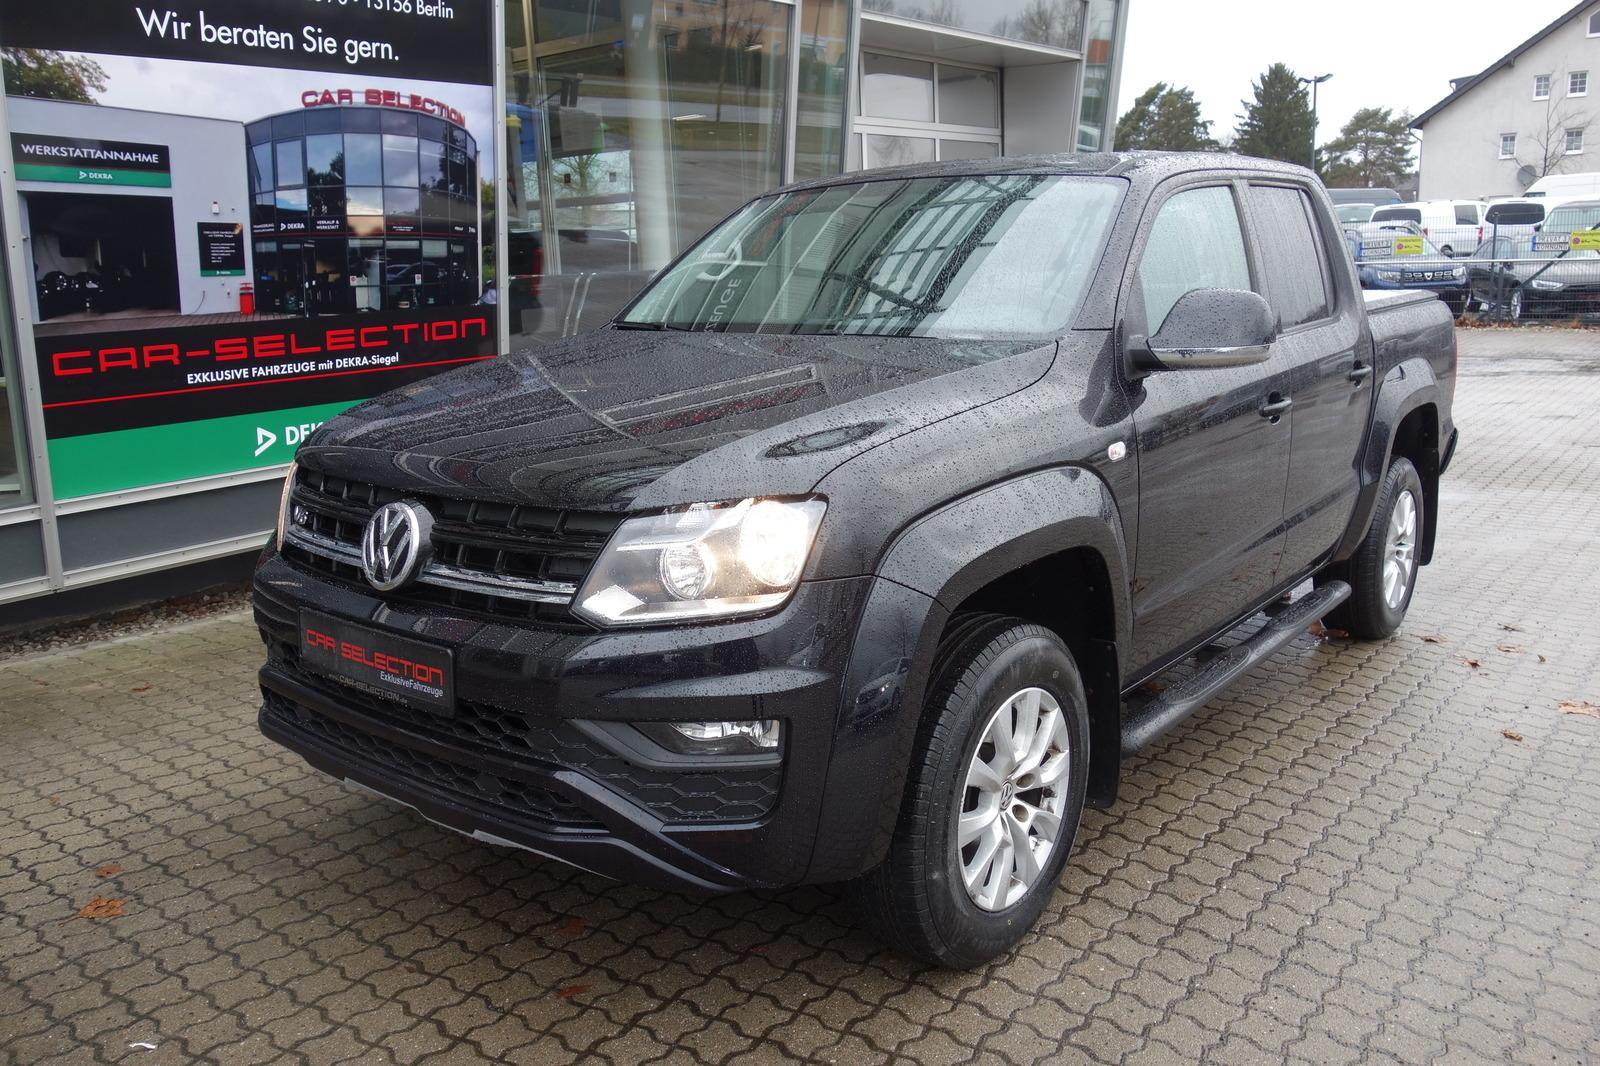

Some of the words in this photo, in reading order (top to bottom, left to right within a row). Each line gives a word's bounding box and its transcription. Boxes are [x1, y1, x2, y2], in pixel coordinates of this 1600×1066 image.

[416, 0, 454, 19] Berlin
[136, 7, 191, 40] Wir
[199, 10, 294, 50] beraten
[302, 25, 337, 54] Sie
[344, 37, 400, 65] gern.
[301, 89, 353, 108] CAR
[21, 143, 160, 164] WERKSTATTANNAHME
[88, 172, 113, 180] DEKRA
[52, 317, 487, 377] CAR-SELECTION
[186, 367, 250, 385] EXKLUSIVE
[251, 361, 316, 378] FAHRZEUGE
[318, 359, 334, 371] mit
[335, 352, 400, 369] DEKRA-Siegel
[306, 628, 337, 653] CAR
[340, 641, 444, 687] SELECTION
